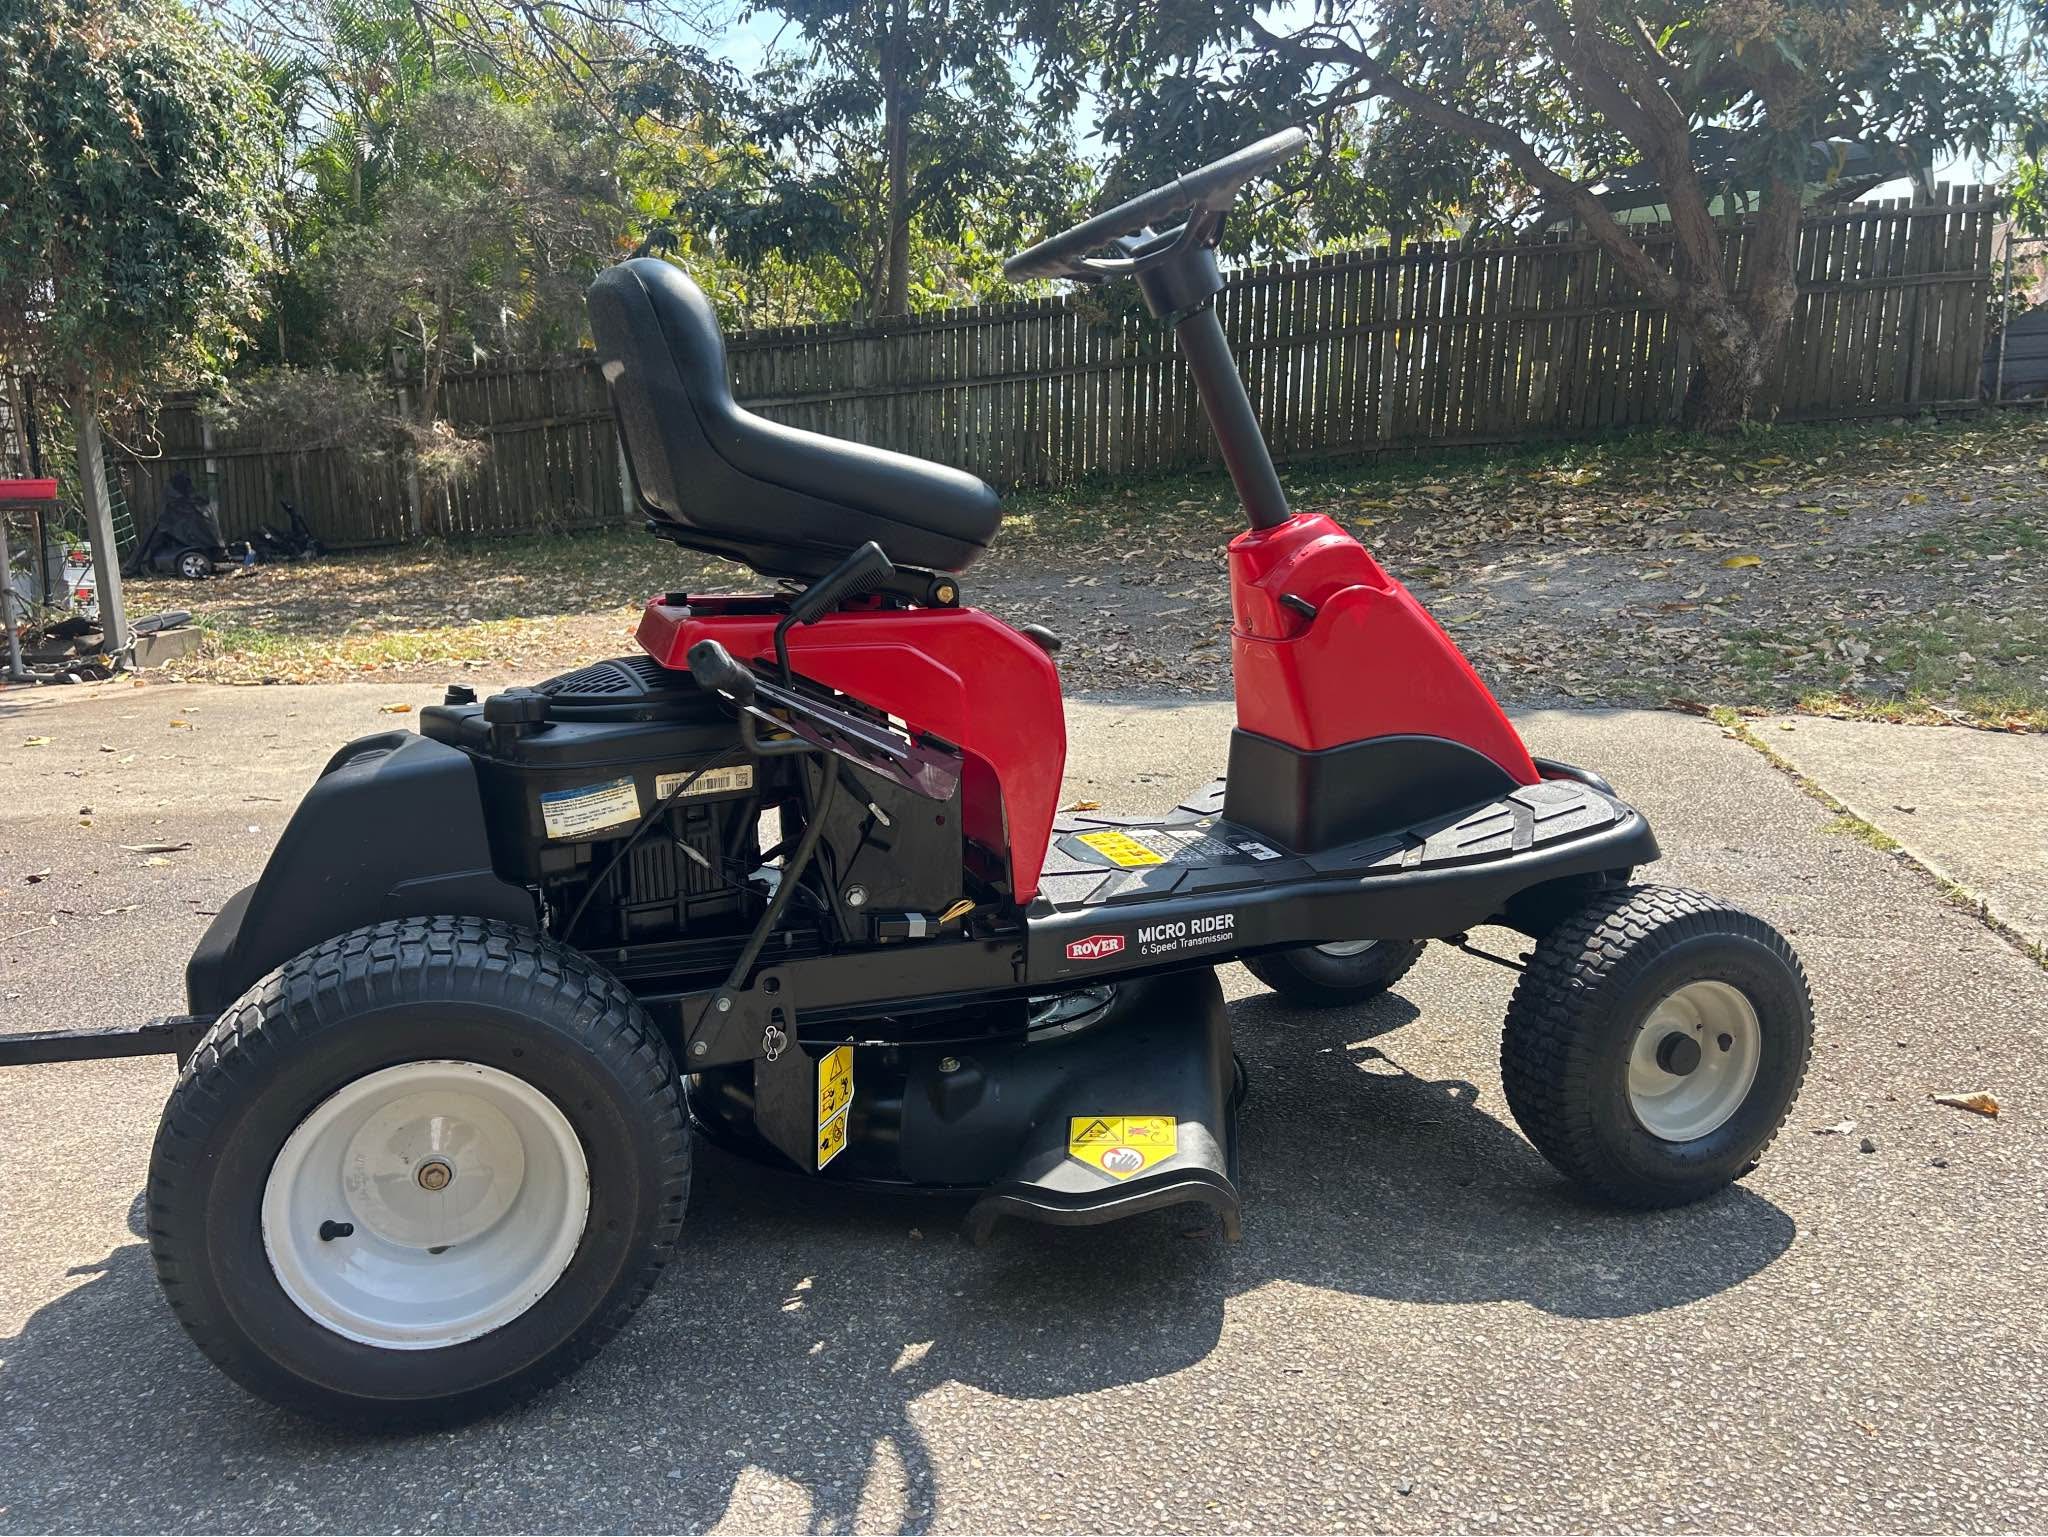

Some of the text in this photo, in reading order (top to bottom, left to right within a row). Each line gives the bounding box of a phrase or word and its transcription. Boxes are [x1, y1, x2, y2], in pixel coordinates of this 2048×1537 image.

[1138, 913, 1235, 943] MICRO RIDER
[1072, 937, 1119, 957] ROVER
[1141, 931, 1233, 955] 6 Speed Transmission
